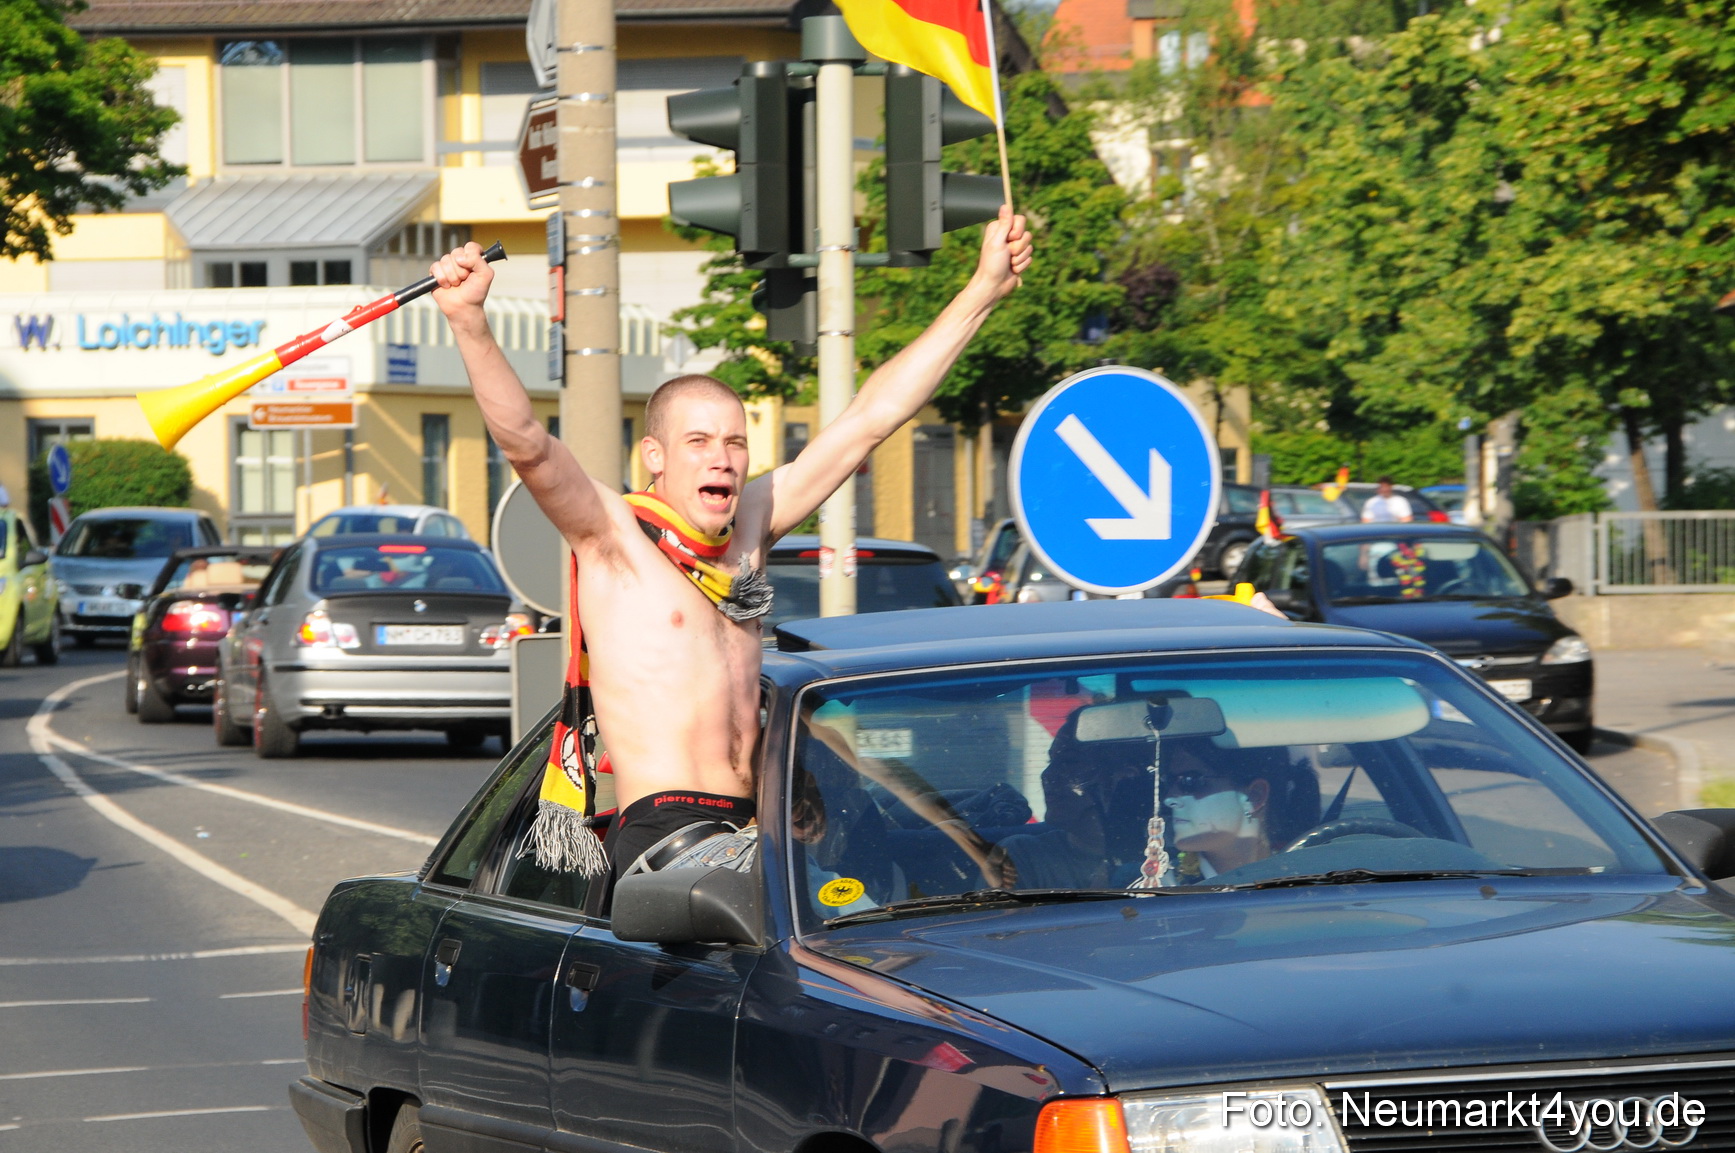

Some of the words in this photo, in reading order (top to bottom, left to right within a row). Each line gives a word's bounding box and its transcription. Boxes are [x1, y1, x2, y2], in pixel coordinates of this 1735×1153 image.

[77, 312, 267, 356] Loichinger
[654, 794, 695, 807] pierre
[698, 797, 734, 809] cardin
